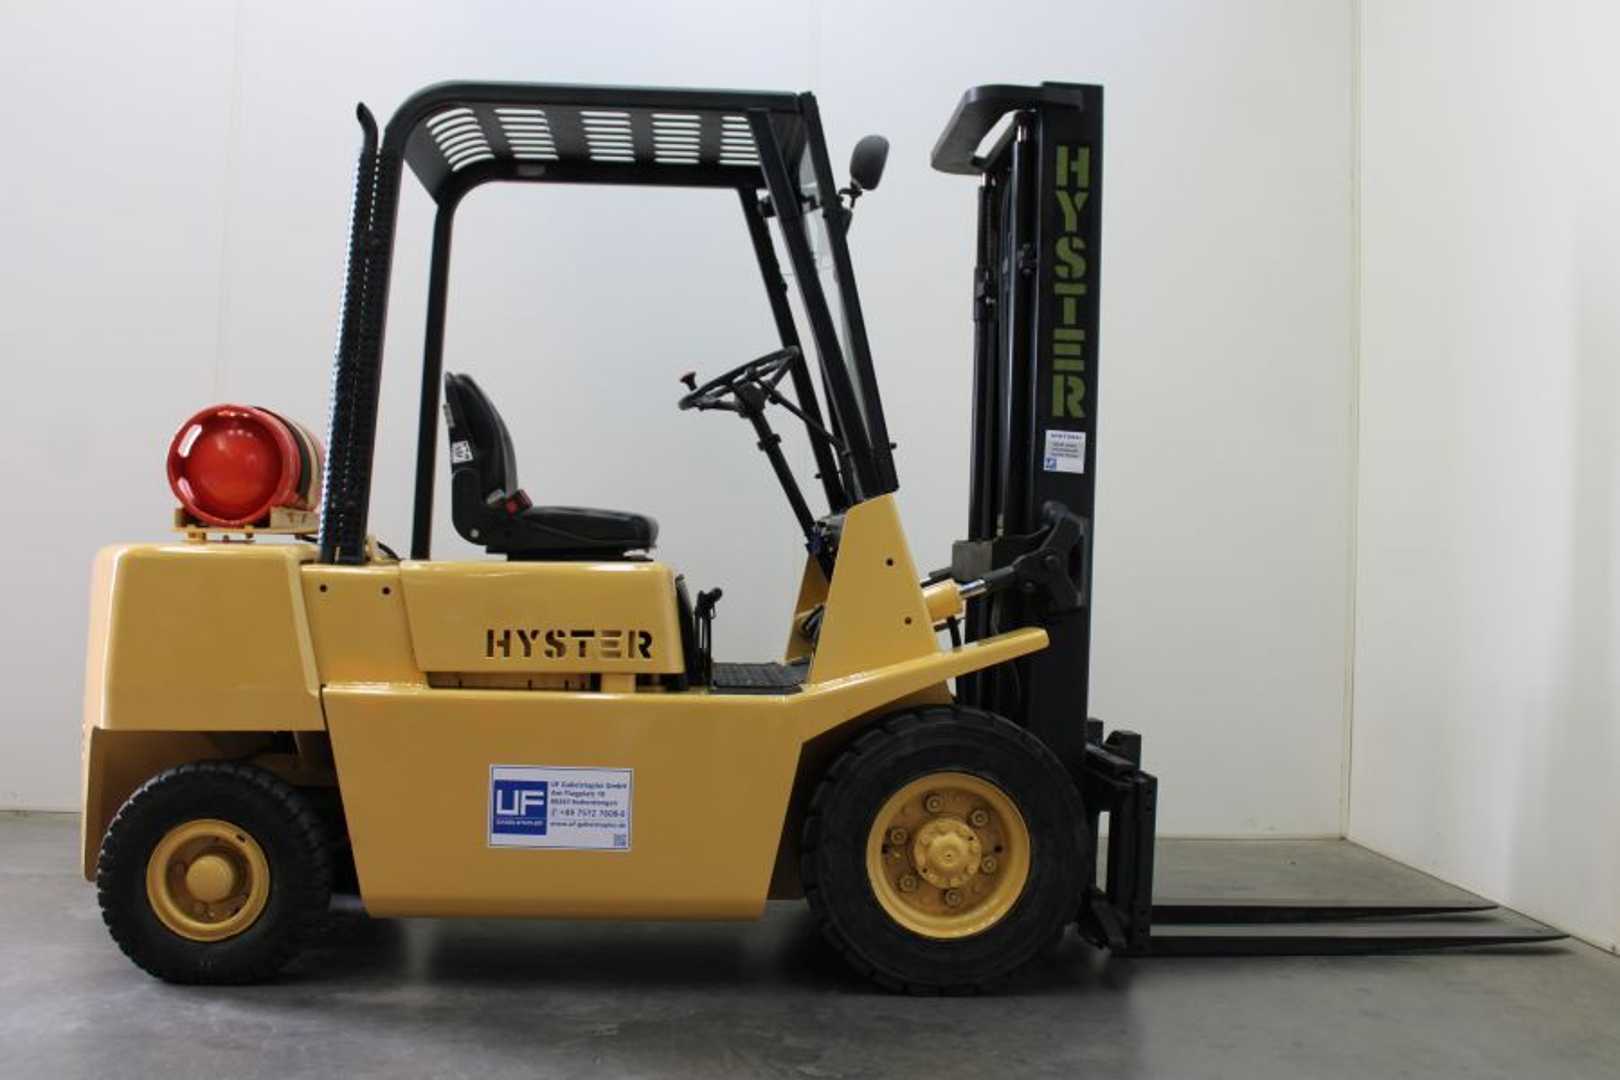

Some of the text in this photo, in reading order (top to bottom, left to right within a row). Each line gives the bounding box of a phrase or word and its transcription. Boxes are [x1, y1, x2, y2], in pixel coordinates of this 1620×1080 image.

[1052, 145, 1091, 418] HYSTER
[486, 629, 653, 659] HYSTER
[496, 789, 545, 816] UF
